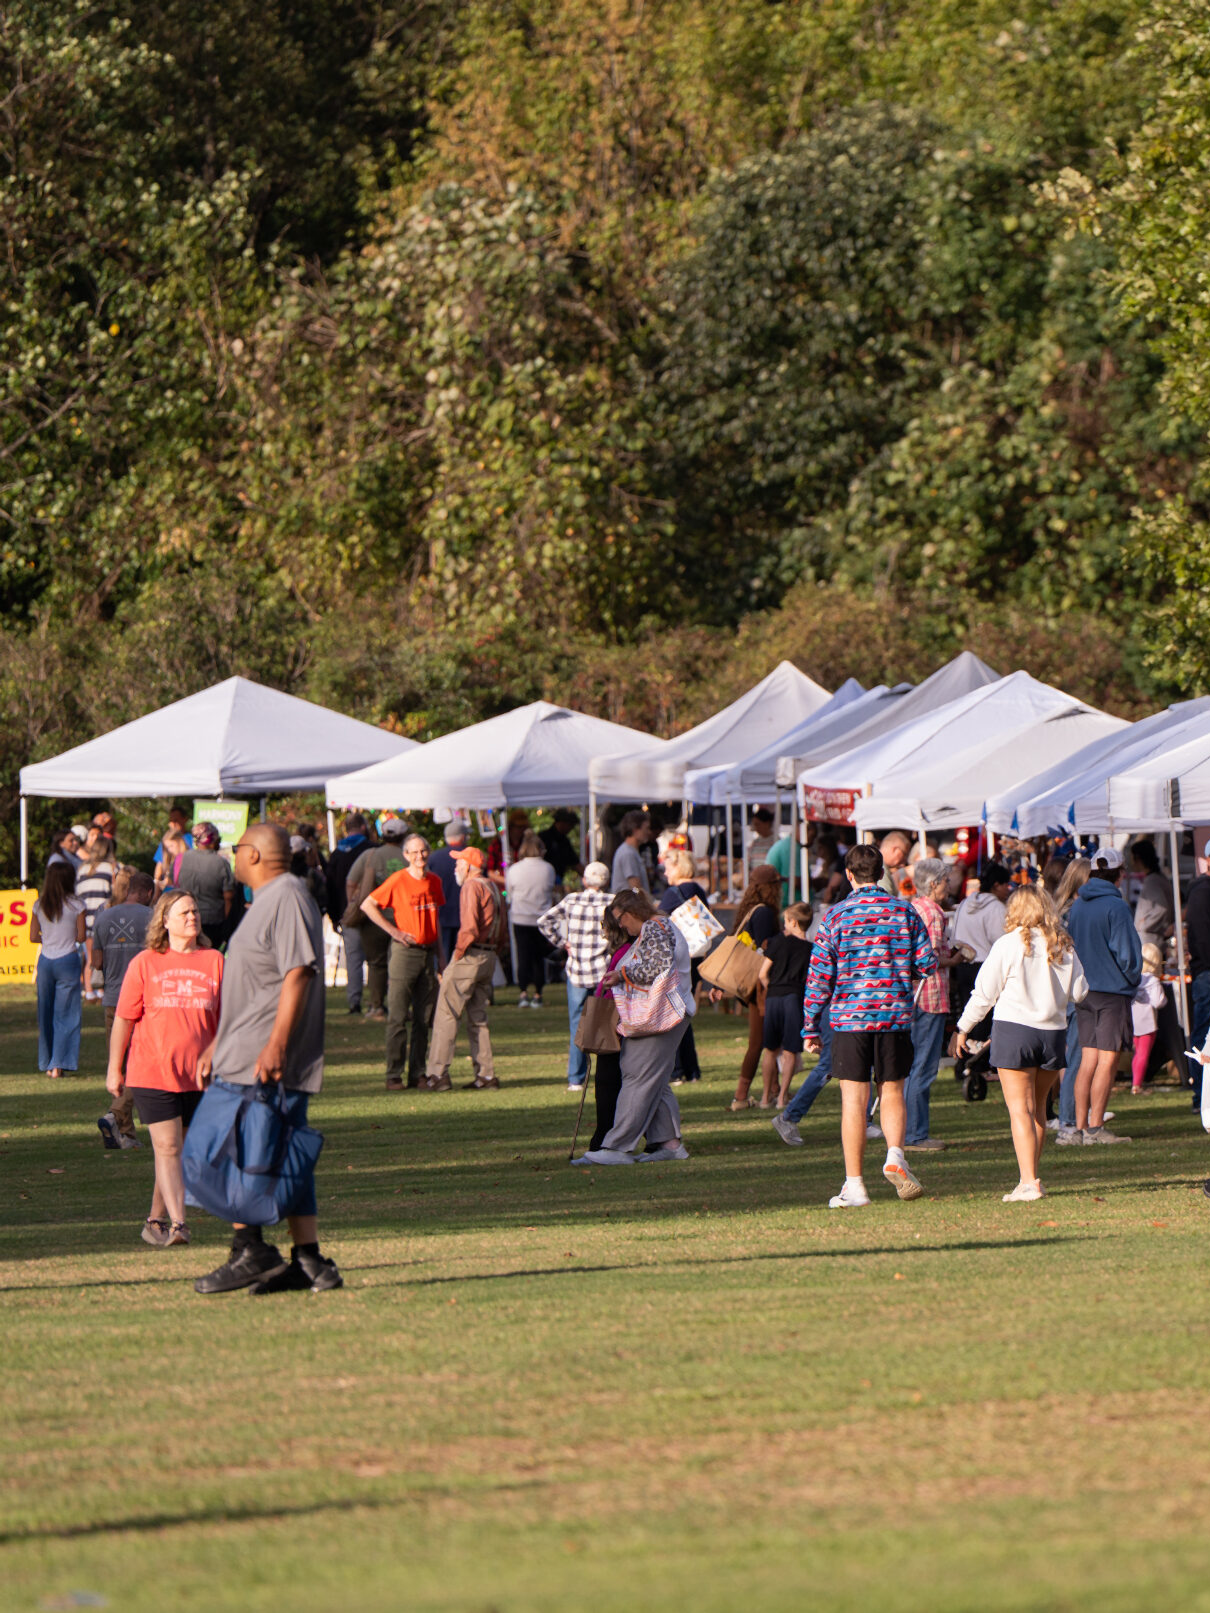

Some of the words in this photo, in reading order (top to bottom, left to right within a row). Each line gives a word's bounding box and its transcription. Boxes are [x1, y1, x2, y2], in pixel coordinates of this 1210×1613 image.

[0, 900, 28, 926] S
[0, 935, 19, 947] IC
[176, 979, 193, 996] M
